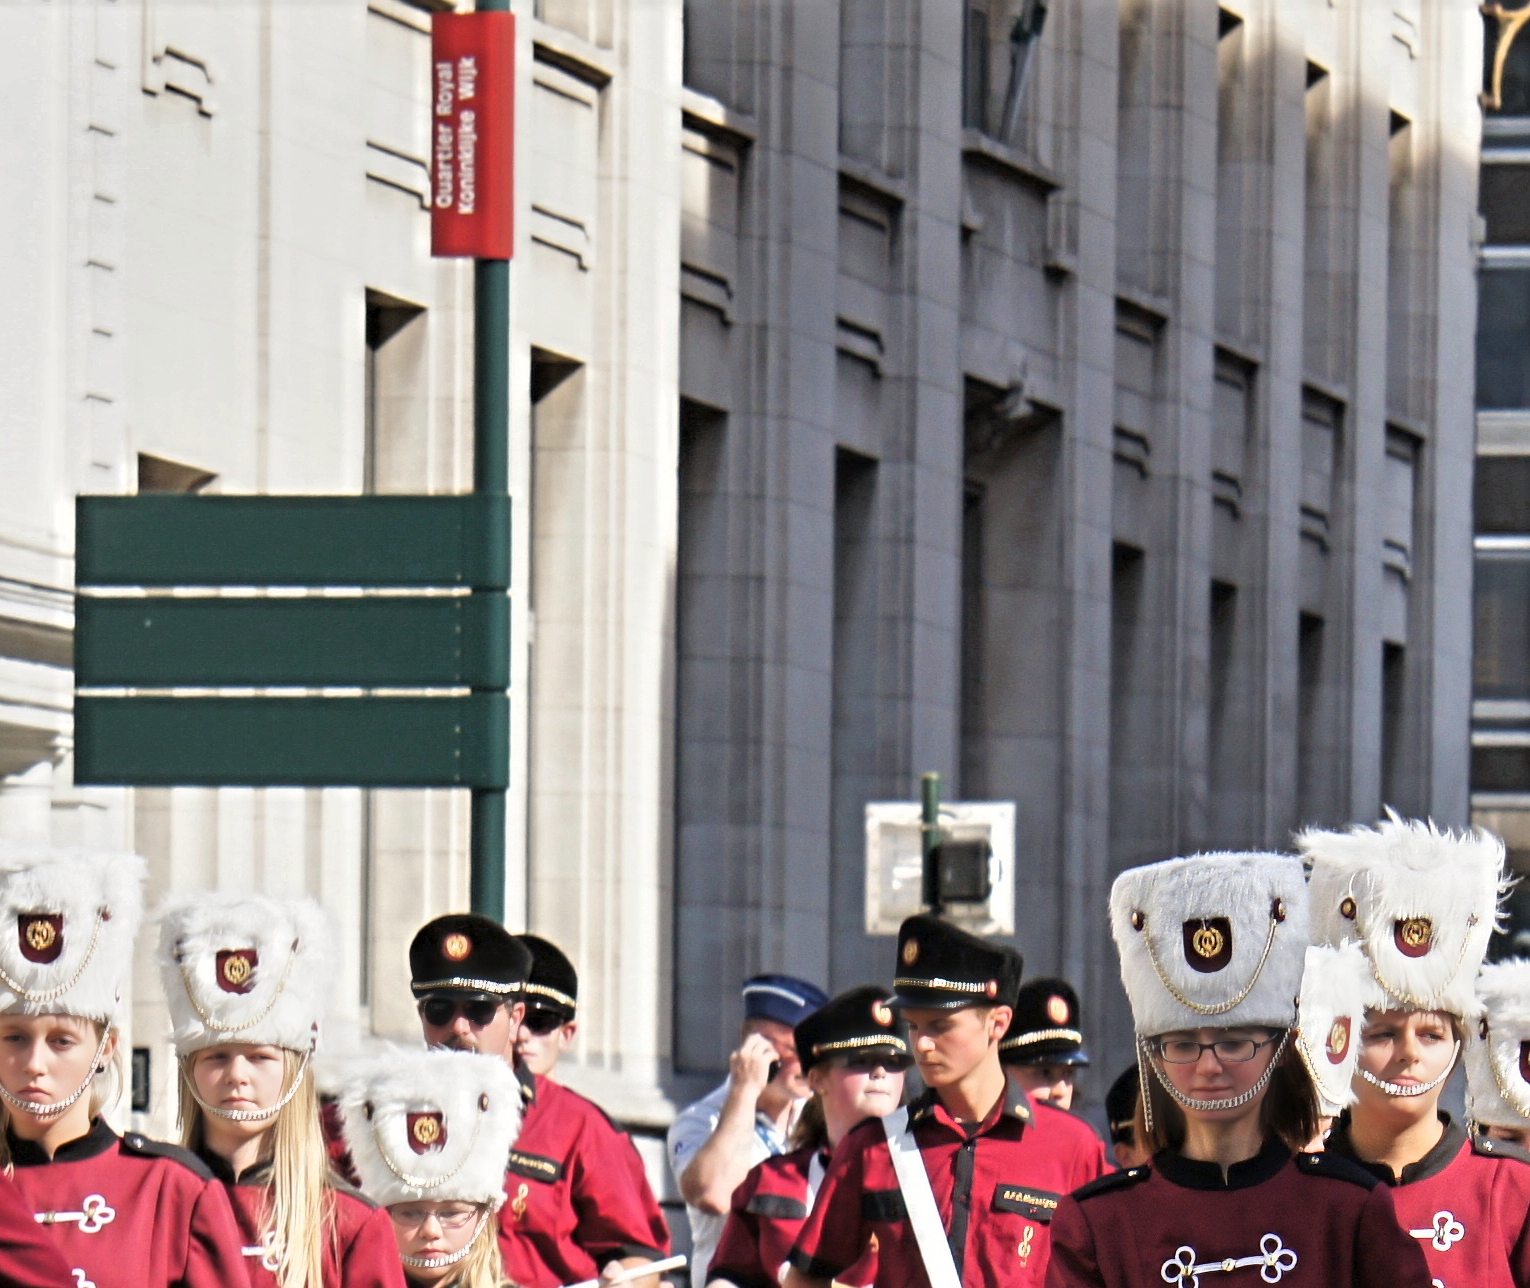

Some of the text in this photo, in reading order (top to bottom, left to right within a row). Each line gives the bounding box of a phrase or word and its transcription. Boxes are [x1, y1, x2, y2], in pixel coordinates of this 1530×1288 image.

[436, 62, 455, 209] Quartier Royal
[458, 57, 477, 214] Koninklijke Wijk
